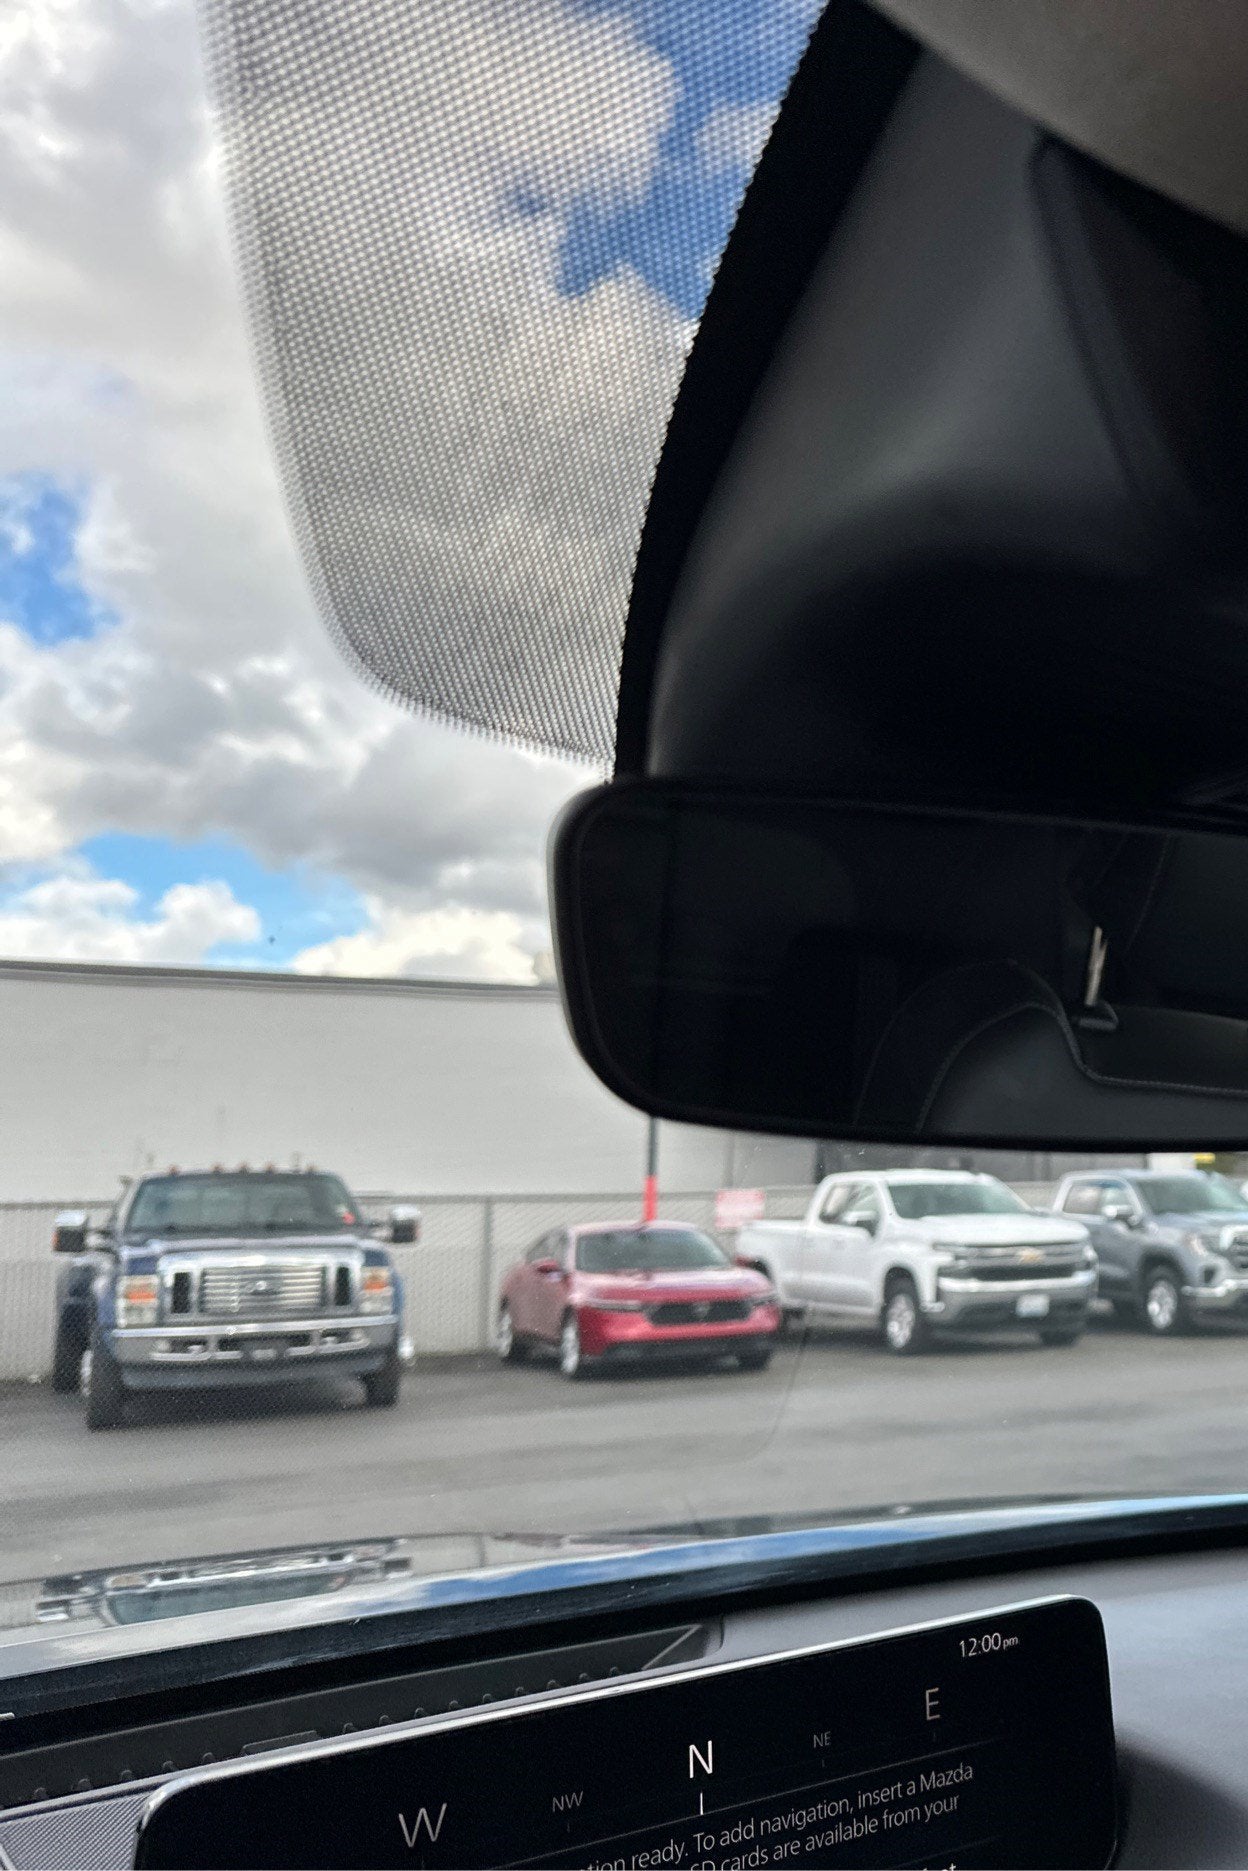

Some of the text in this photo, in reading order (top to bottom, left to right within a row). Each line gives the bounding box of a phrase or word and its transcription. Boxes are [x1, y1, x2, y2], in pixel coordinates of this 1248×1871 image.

[398, 1687, 941, 1848] W NW N NE E
[631, 1838, 689, 1870] ready.
[692, 1832, 715, 1853] To
[719, 1817, 755, 1846] add
[760, 1797, 853, 1837] navigation,
[857, 1781, 903, 1810] insert
[906, 1780, 916, 1796] a
[920, 1762, 973, 1792] Mazda
[720, 1845, 769, 1870] cards
[773, 1839, 801, 1861] are
[805, 1815, 879, 1852] available
[882, 1805, 921, 1830] from
[923, 1794, 960, 1823] your
